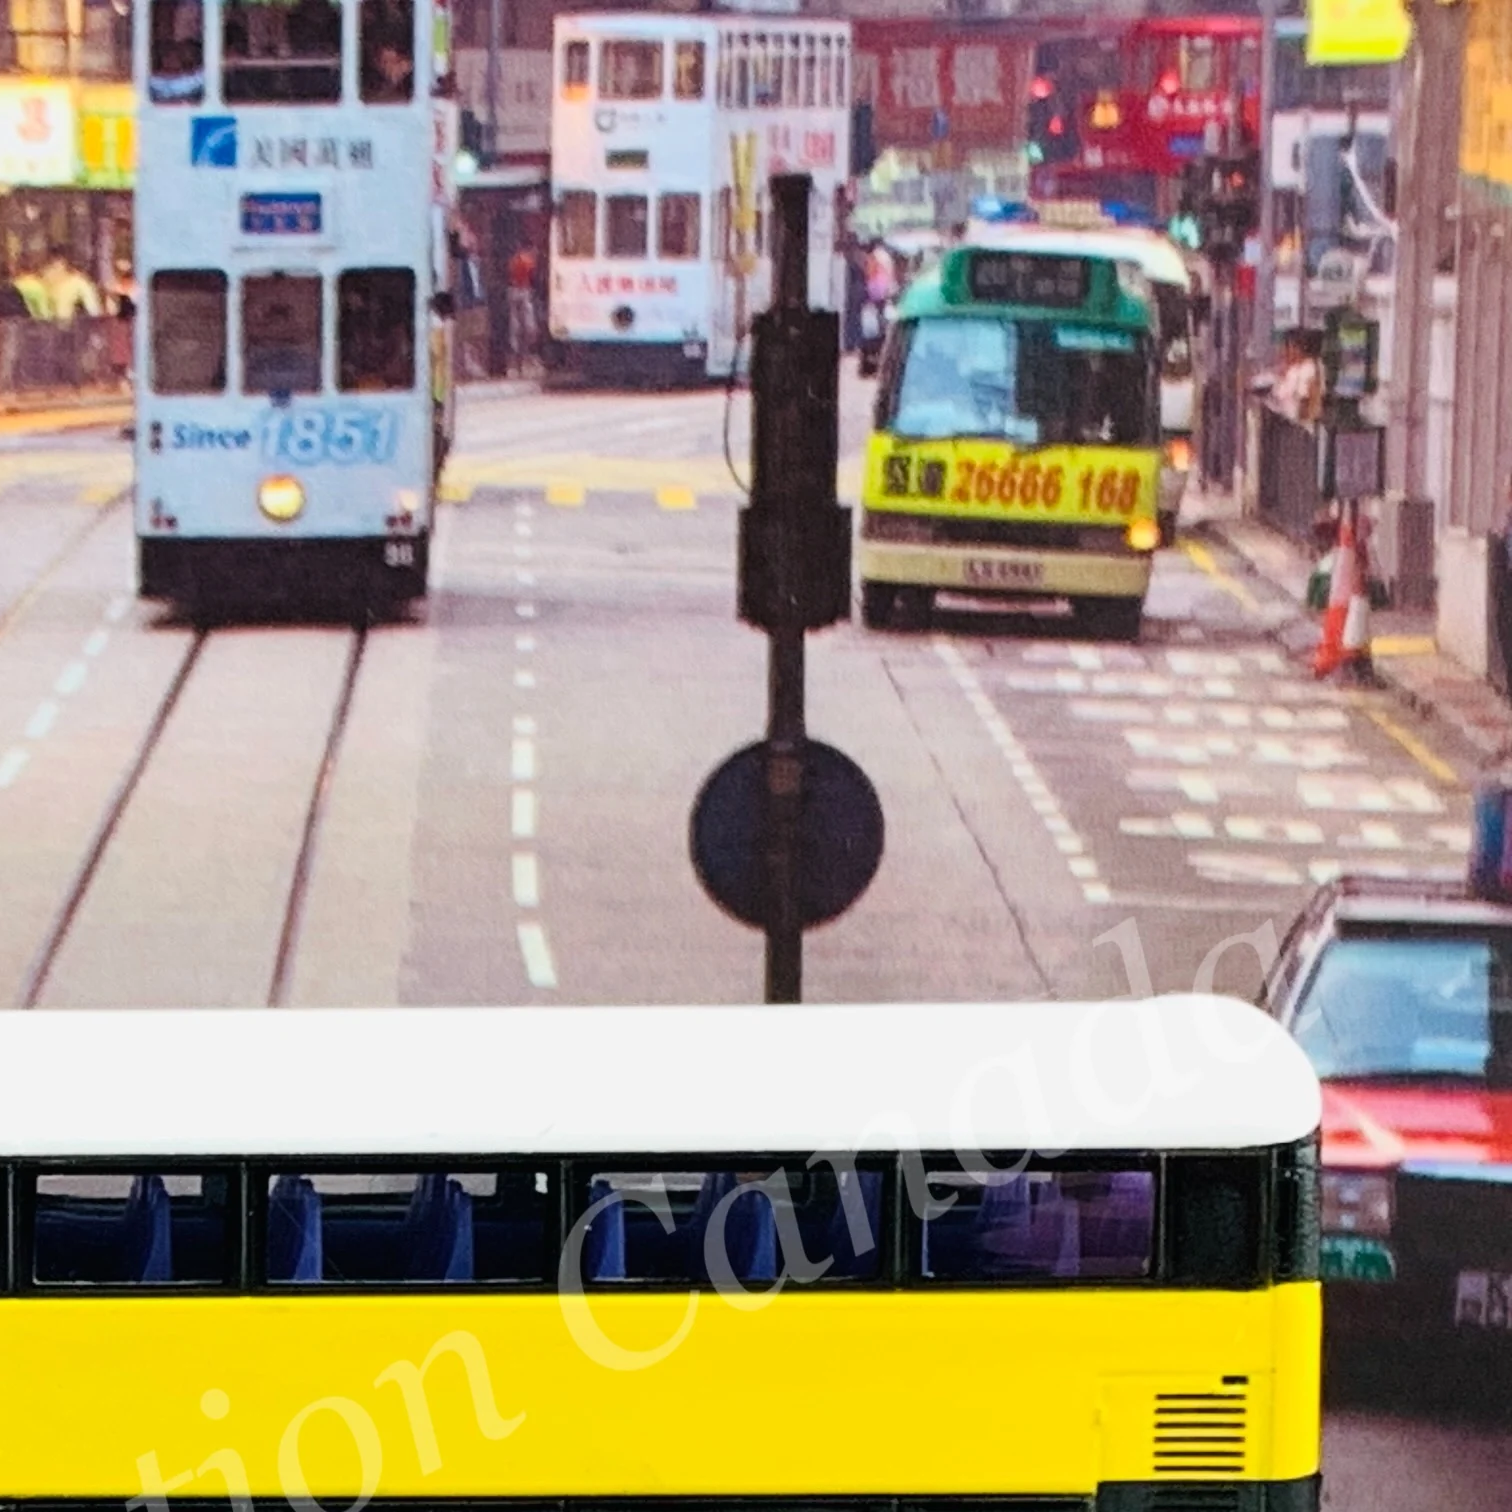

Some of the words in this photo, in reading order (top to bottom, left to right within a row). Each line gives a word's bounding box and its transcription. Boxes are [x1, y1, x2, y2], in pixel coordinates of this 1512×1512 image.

[172, 422, 252, 449] Since
[258, 410, 400, 466] 1851
[1080, 464, 1140, 516] 168
